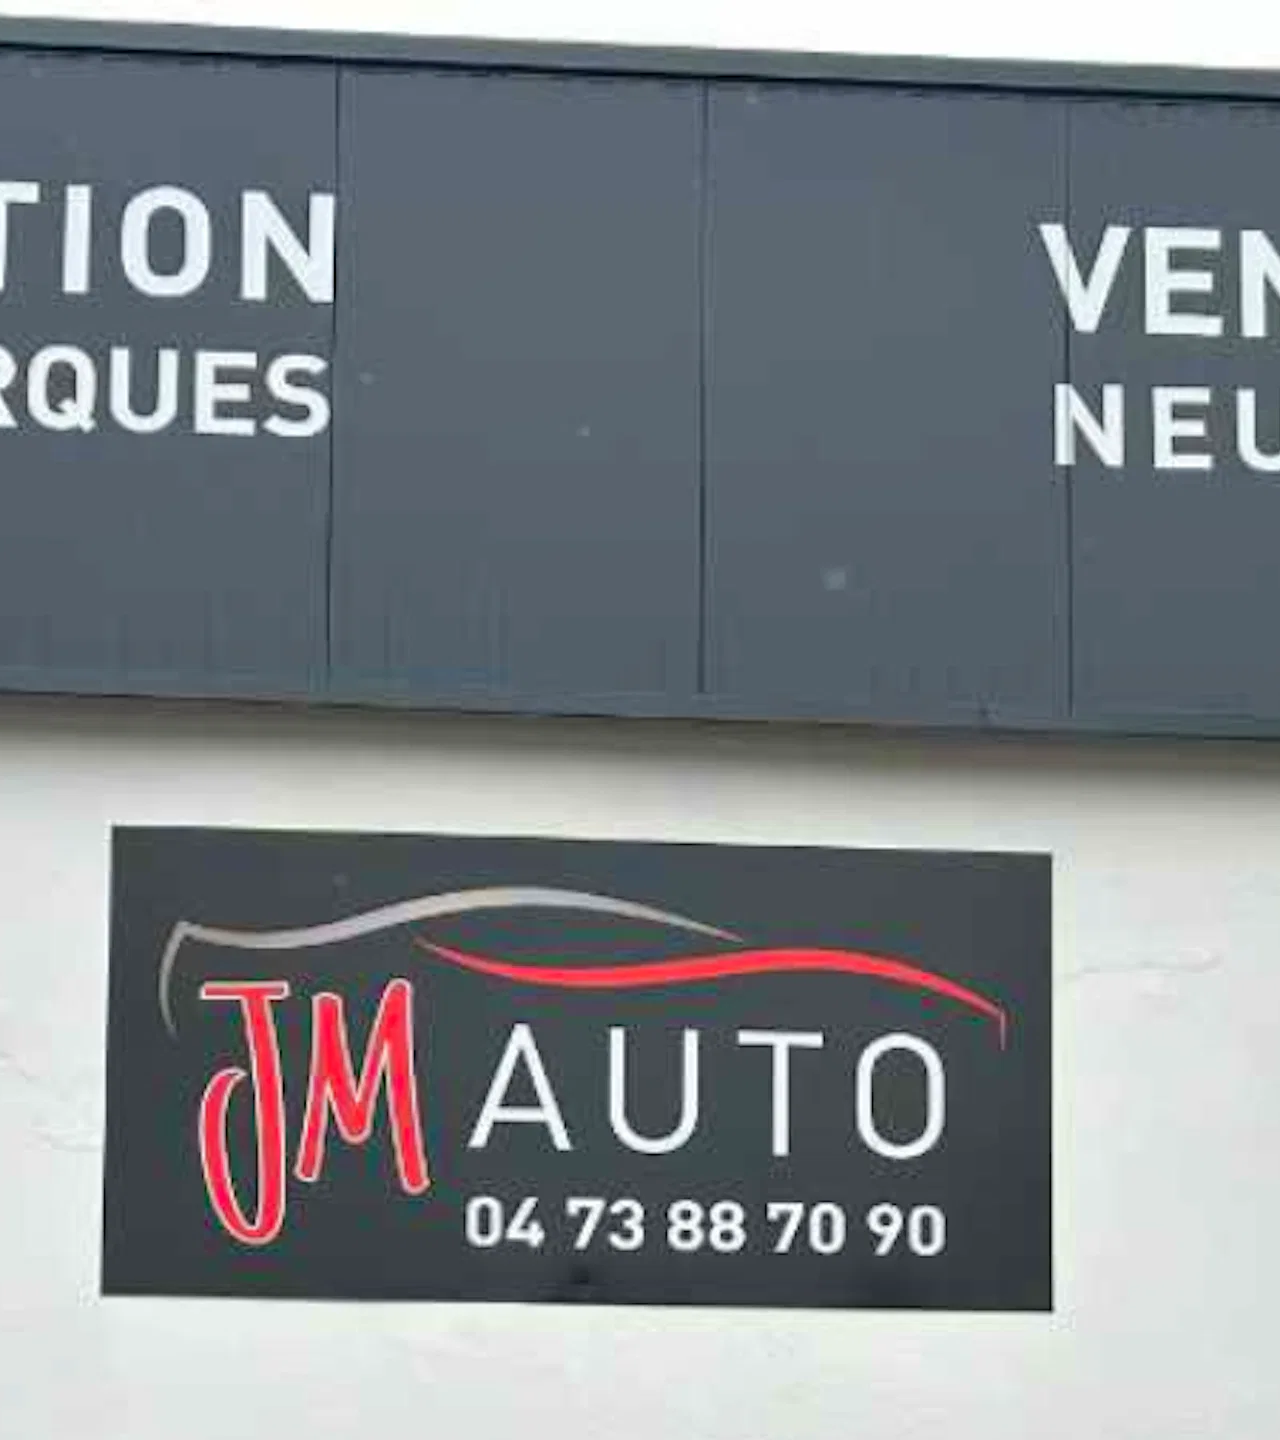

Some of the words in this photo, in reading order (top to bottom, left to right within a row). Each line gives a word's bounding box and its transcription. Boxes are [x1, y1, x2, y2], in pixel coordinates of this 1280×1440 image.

[198, 977, 430, 1246] JM
[467, 1022, 947, 1161] AUTO
[464, 1195, 546, 1249] 04
[565, 1197, 646, 1252] 73
[666, 1198, 748, 1253] 88
[766, 1201, 848, 1255] 70
[865, 1203, 947, 1257] 90
